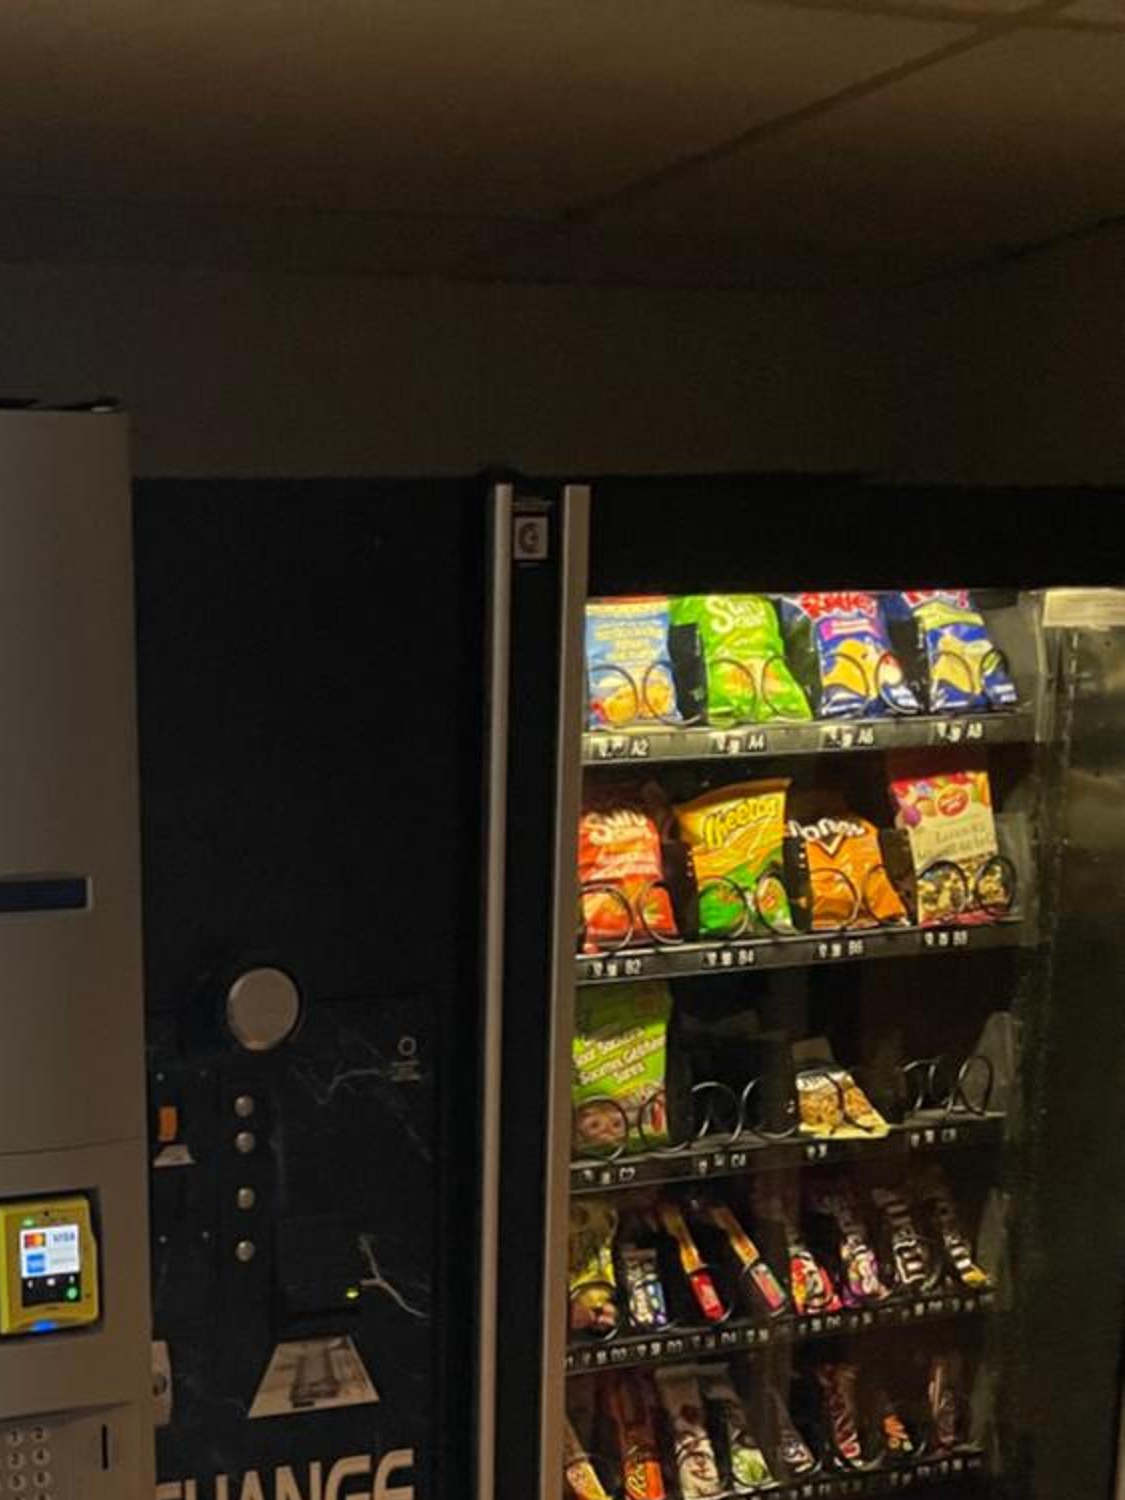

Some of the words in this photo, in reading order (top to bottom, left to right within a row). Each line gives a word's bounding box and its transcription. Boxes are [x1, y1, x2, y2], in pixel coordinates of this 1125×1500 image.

[631, 739, 647, 756] A2
[749, 734, 764, 750] A4
[702, 797, 778, 848] Cheetos
[52, 1232, 75, 1243] VISA
